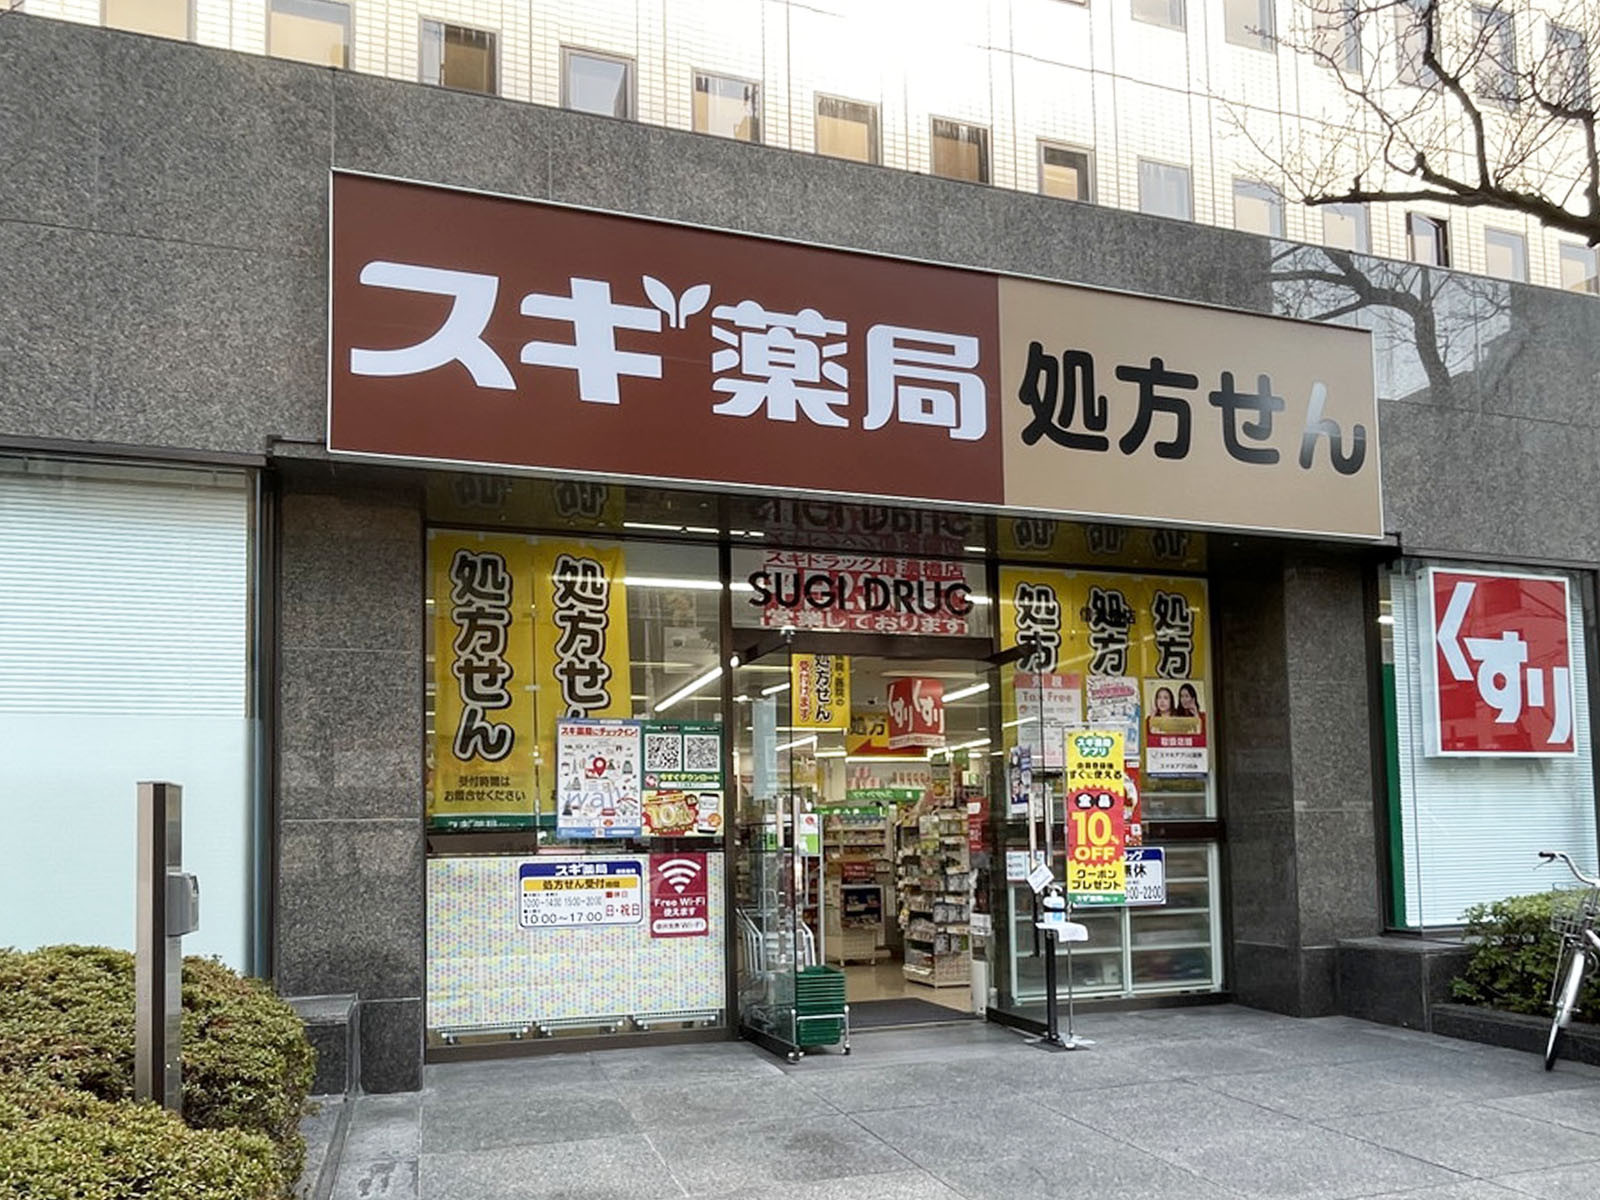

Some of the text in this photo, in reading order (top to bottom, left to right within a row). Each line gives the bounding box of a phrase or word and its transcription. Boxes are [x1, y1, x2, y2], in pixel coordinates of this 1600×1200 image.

[350, 260, 987, 440] スギ薬局
[1018, 341, 1367, 475] 処方せん
[553, 553, 612, 718] 処方せ
[748, 571, 974, 617] SUGI DRUG
[450, 550, 515, 761] 処方せん
[1437, 582, 1571, 744] くすり
[1072, 881, 1122, 890] プレゼント
[1075, 847, 1116, 861] OFF
[1077, 869, 1117, 879] クーポン
[655, 896, 706, 907] Free Wi-Fi
